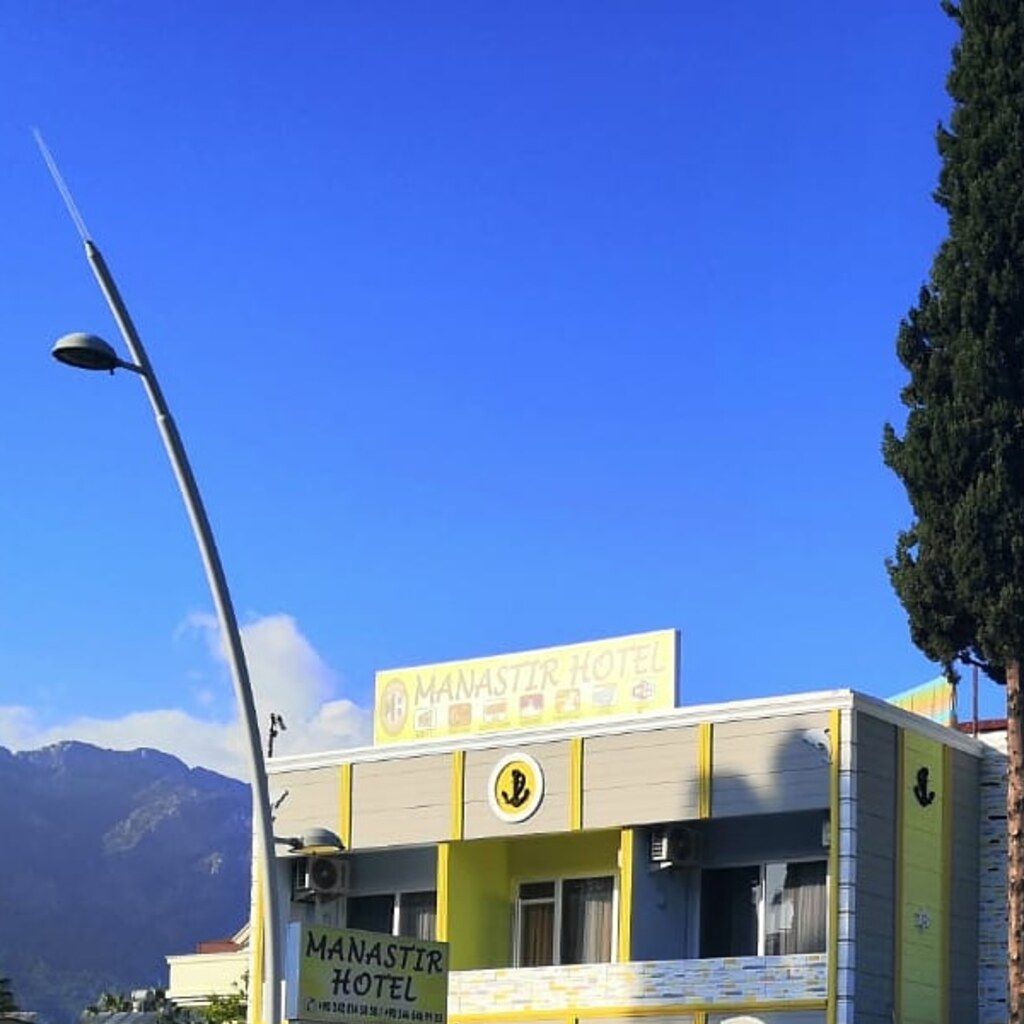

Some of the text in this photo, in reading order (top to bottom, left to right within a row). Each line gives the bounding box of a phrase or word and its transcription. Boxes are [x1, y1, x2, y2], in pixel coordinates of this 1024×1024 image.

[414, 641, 665, 705] MANASTIR HOTEL
[306, 930, 443, 974] MANASTIR
[331, 968, 418, 1002] HOTEL
